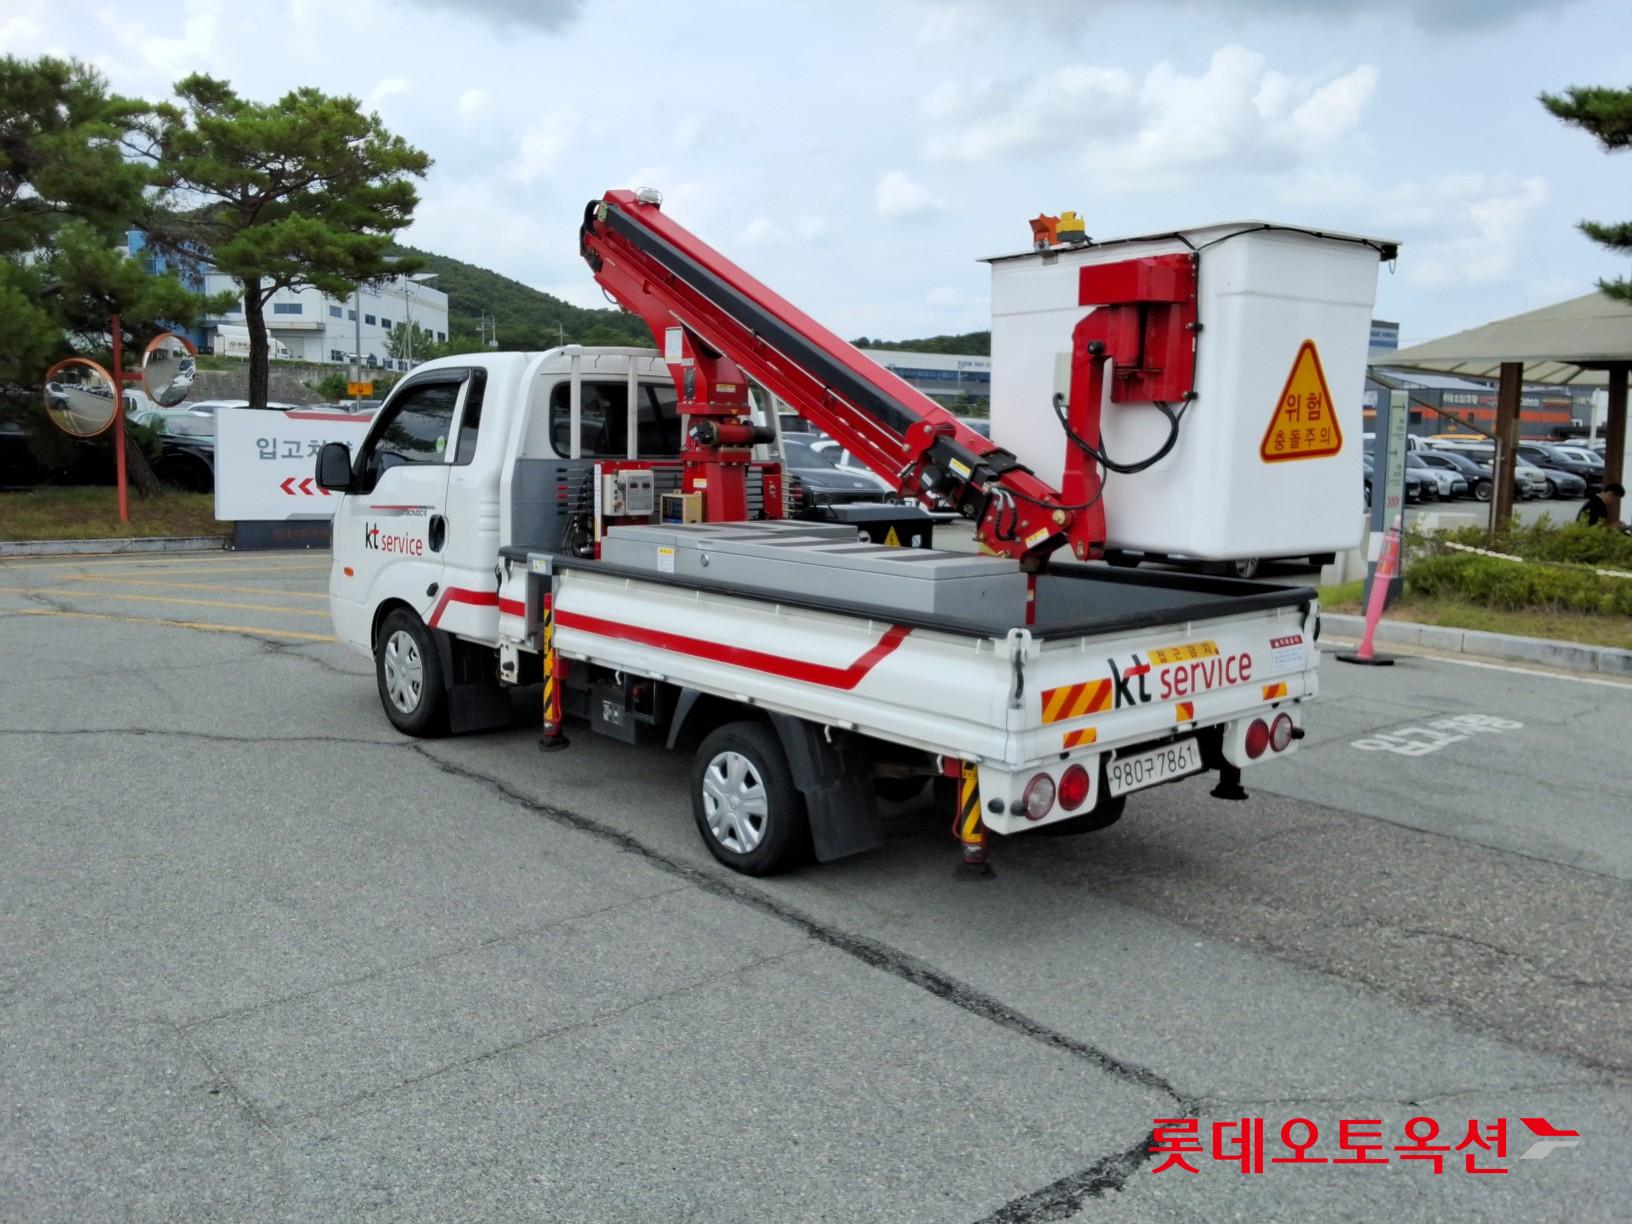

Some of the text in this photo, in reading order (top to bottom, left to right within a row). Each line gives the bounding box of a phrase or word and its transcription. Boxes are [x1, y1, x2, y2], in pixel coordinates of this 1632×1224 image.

[1285, 392, 1322, 423] 위험
[1273, 426, 1331, 451] 충돌주의
[365, 522, 423, 556] kt service
[1107, 652, 1252, 709] kt service
